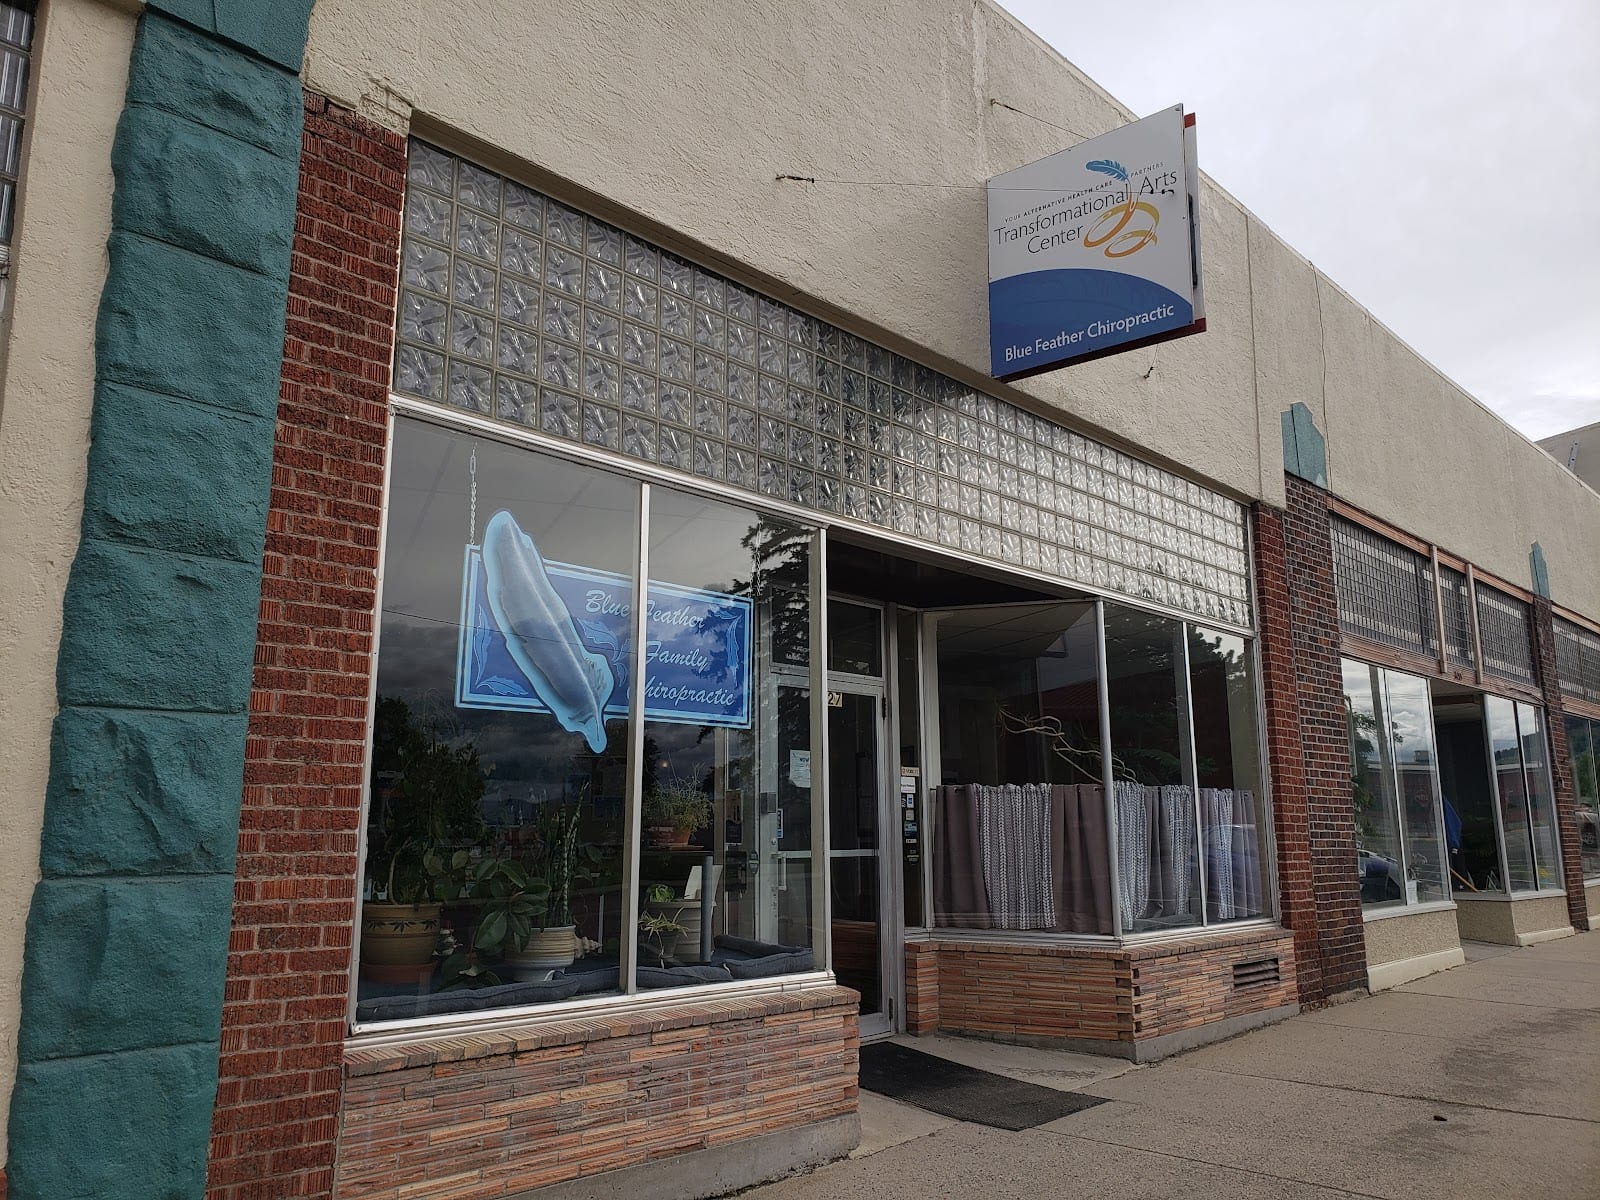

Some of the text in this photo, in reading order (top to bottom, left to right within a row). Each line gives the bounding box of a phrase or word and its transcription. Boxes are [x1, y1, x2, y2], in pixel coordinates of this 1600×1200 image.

[994, 170, 1177, 245] Transformational Arts
[1005, 161, 1164, 223] YOUR ALTERNATIVE HEALTH CARE PARTNERS
[1027, 226, 1084, 254] Center
[1005, 303, 1175, 362] Blue Feather Chiropractic
[585, 589, 629, 618] Blue
[646, 640, 711, 671] Family
[627, 676, 736, 706] hiropractic
